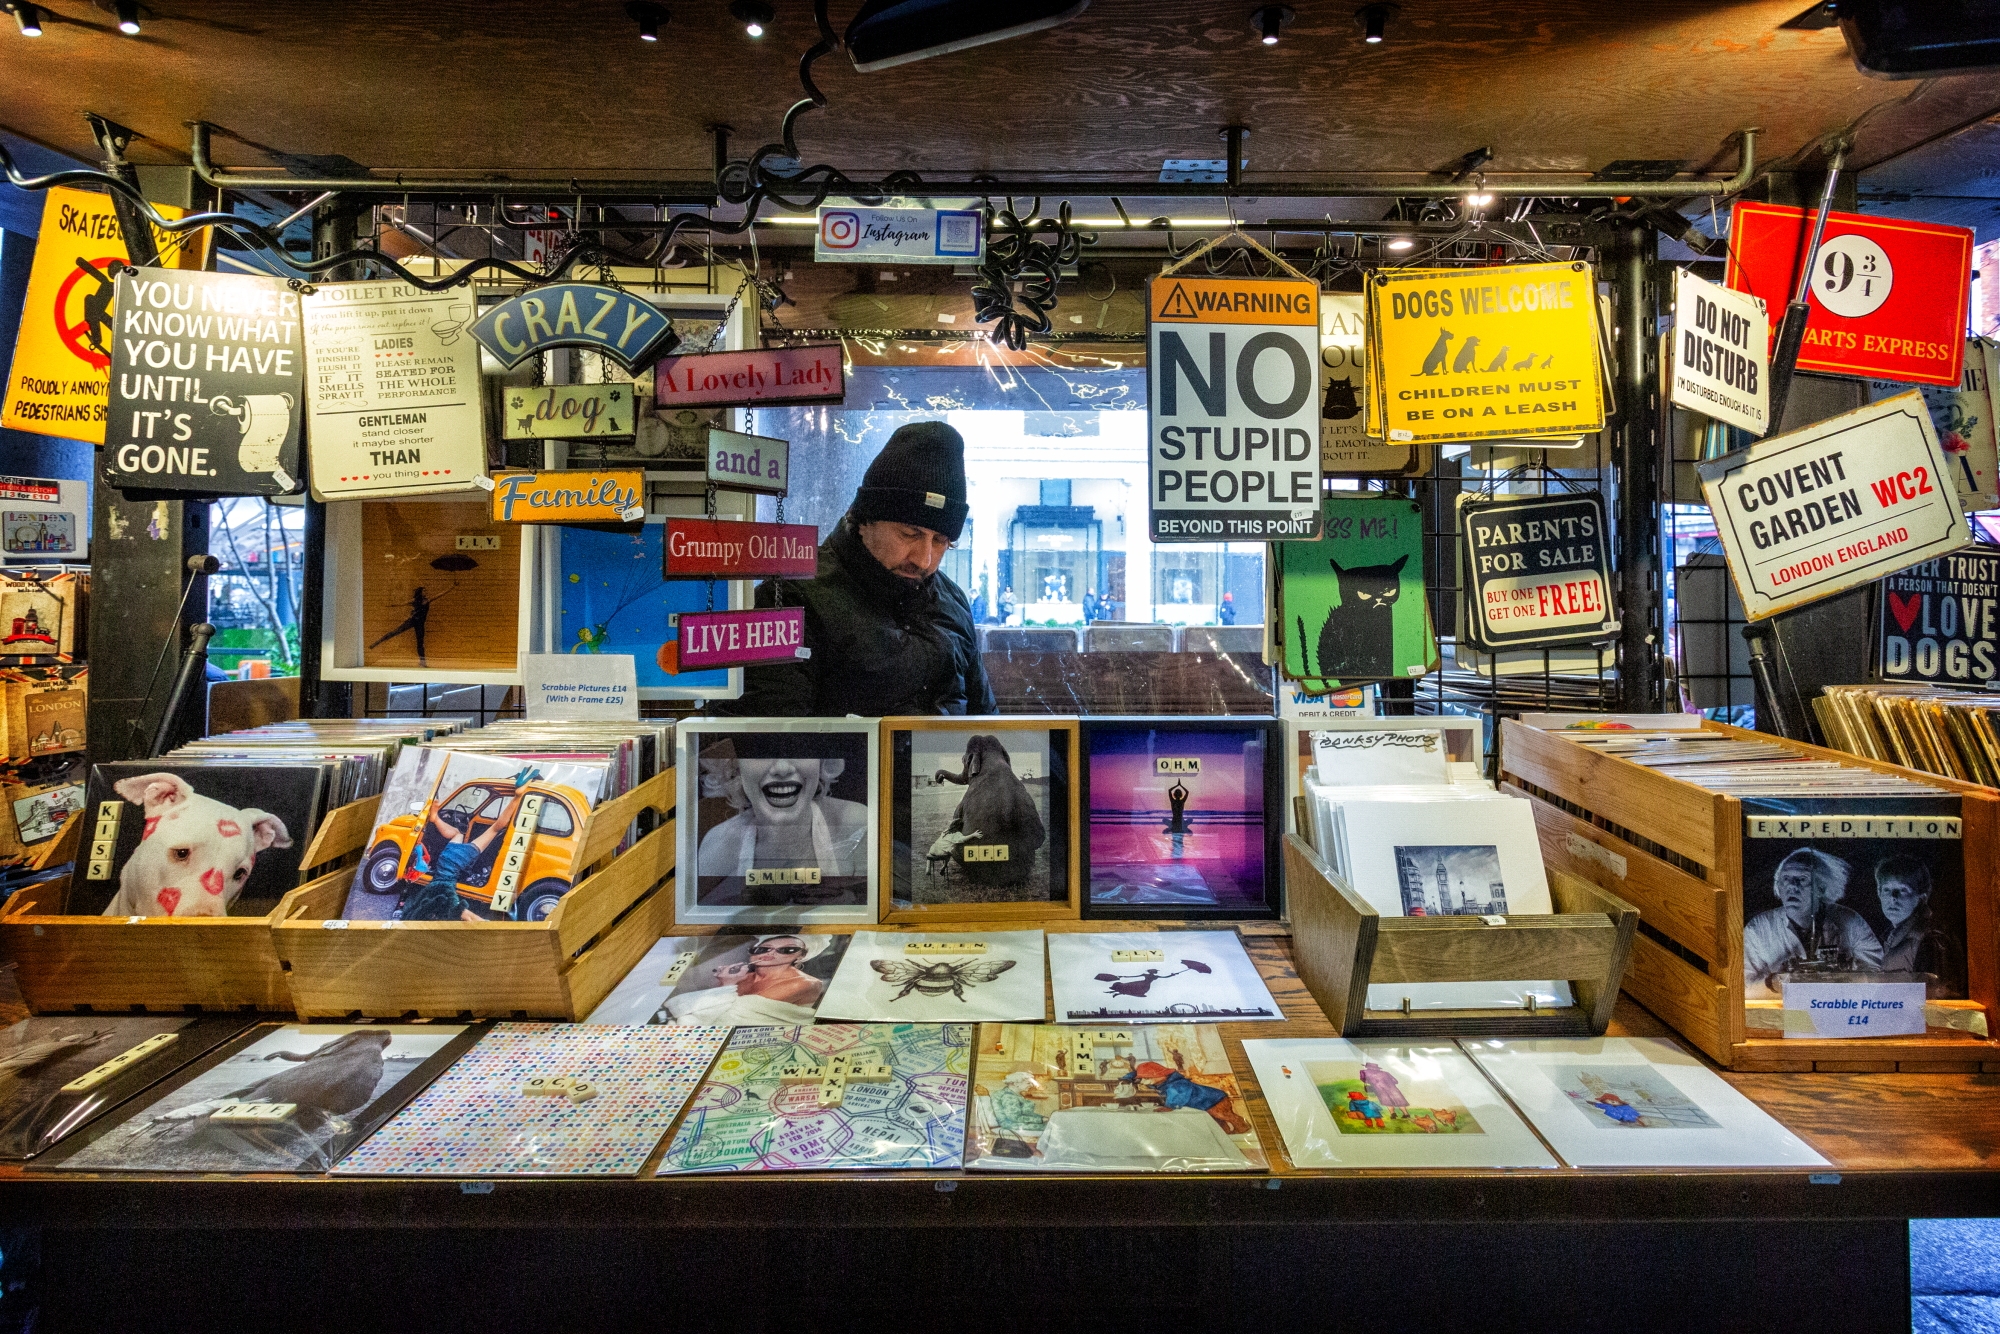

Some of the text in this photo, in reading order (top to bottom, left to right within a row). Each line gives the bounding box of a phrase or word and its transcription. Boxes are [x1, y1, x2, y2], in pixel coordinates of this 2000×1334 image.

[871, 214, 894, 223] Follow
[907, 216, 918, 224] On
[861, 223, 930, 247] Instagram
[1823, 250, 1855, 294] 9
[131, 280, 298, 317] YOU NEVER
[320, 286, 387, 302] TOILET
[1194, 289, 1311, 315] WARNING
[1391, 280, 1575, 320] DOGS WELCOME
[320, 313, 337, 322] you
[340, 310, 353, 318] lift
[356, 309, 363, 317] it
[382, 307, 397, 317] put
[399, 307, 406, 316] it
[408, 306, 434, 315] down
[494, 291, 652, 356] CRAZY
[1695, 294, 1751, 351] DO NOT
[124, 309, 297, 345] KNOW WHAT
[326, 347, 360, 355] YOU'RE
[374, 338, 414, 350] LADIES
[1862, 335, 1950, 362] EXPRESS
[124, 339, 294, 376] YOU HAVE
[317, 354, 361, 363] FINISHED
[375, 356, 454, 368] PLEASE REMAIN
[1683, 329, 1759, 397] DISTURB
[318, 364, 347, 372] FLUSH
[375, 366, 456, 379] SEATED FOR
[659, 358, 838, 396] A Lovely Lady
[1157, 330, 1313, 420] NO
[21, 376, 69, 395] PROUDLY
[120, 373, 209, 404] UNTIL
[318, 383, 364, 392] SMELLS
[319, 374, 362, 384] IF IT
[377, 376, 456, 390] THE WHOLE
[318, 392, 351, 401] SPRAY
[377, 388, 457, 399] PERFORMANCE
[1398, 378, 1583, 401] CHILDREN MUST
[1677, 375, 1762, 421] I'M DISTURBED ENOUGH AS IT IS
[14, 401, 90, 421] PEDESTRIANS
[535, 388, 607, 430] dog
[1406, 400, 1577, 422] BE ON A LEASH
[132, 409, 192, 441] IT'S
[358, 412, 427, 428] GENTLEMAN
[361, 427, 424, 437] stand closer
[361, 439, 396, 449] maybe
[398, 436, 434, 445] shorter
[1157, 425, 1313, 463] STUPID
[118, 444, 217, 477] GONE.
[370, 448, 421, 466] THAN
[715, 448, 780, 480] and a
[1357, 451, 1371, 460] IT.
[372, 469, 420, 481] you thing
[1737, 451, 1847, 513] COVENT
[1157, 469, 1314, 504] PEOPLE
[497, 474, 641, 521] Family
[1749, 466, 1934, 550] GARDEN WC2
[1158, 519, 1315, 535] BEYOND THIS POINT
[1359, 517, 1399, 540] ME!
[1476, 514, 1595, 549] PARENTS
[459, 537, 497, 548] FLY
[669, 531, 814, 565] Grumpy Old Man
[1480, 544, 1596, 574] FOR SALE
[1770, 526, 1910, 586] LONDON ENGLAND
[1947, 556, 1998, 582] TRUST
[1486, 586, 1534, 604] BUY ONE
[1888, 578, 1998, 598] A PERSON THAT DOESN'T
[1536, 579, 1603, 618] FREE!
[1487, 603, 1536, 621] GET ONE
[1922, 593, 1998, 640] LOVE
[685, 619, 801, 655] LIVE HERE
[1886, 635, 1997, 681] DOGS
[541, 683, 627, 694] Scrabble Pictures £14
[1291, 690, 1325, 704] VISA
[29, 700, 82, 713] LONDON
[546, 694, 568, 706] (With
[578, 695, 604, 705] Frame
[605, 696, 624, 706] £25)
[1160, 758, 1200, 774] OHM
[1757, 821, 1961, 837] EXPEDITION
[92, 805, 114, 877] KISS
[496, 797, 538, 909] CLASSY
[966, 845, 1008, 861] BFF
[748, 869, 821, 885] SMILE
[907, 942, 987, 951] QUEEN
[667, 952, 694, 980] POUT
[1810, 998, 1904, 1010] Scrabble Pictures
[1847, 1015, 1869, 1026] £14
[1078, 1031, 1130, 1040] TEA
[783, 1066, 889, 1078] WHERE
[531, 1077, 589, 1097] OCD
[850, 1085, 889, 1097] LONDON
[221, 1105, 282, 1117] BFF
[779, 1124, 814, 1140] ARRIVAL
[861, 1125, 902, 1144] NEPAL
[789, 1136, 829, 1156] ROME
[803, 1146, 826, 1160] ITALY
